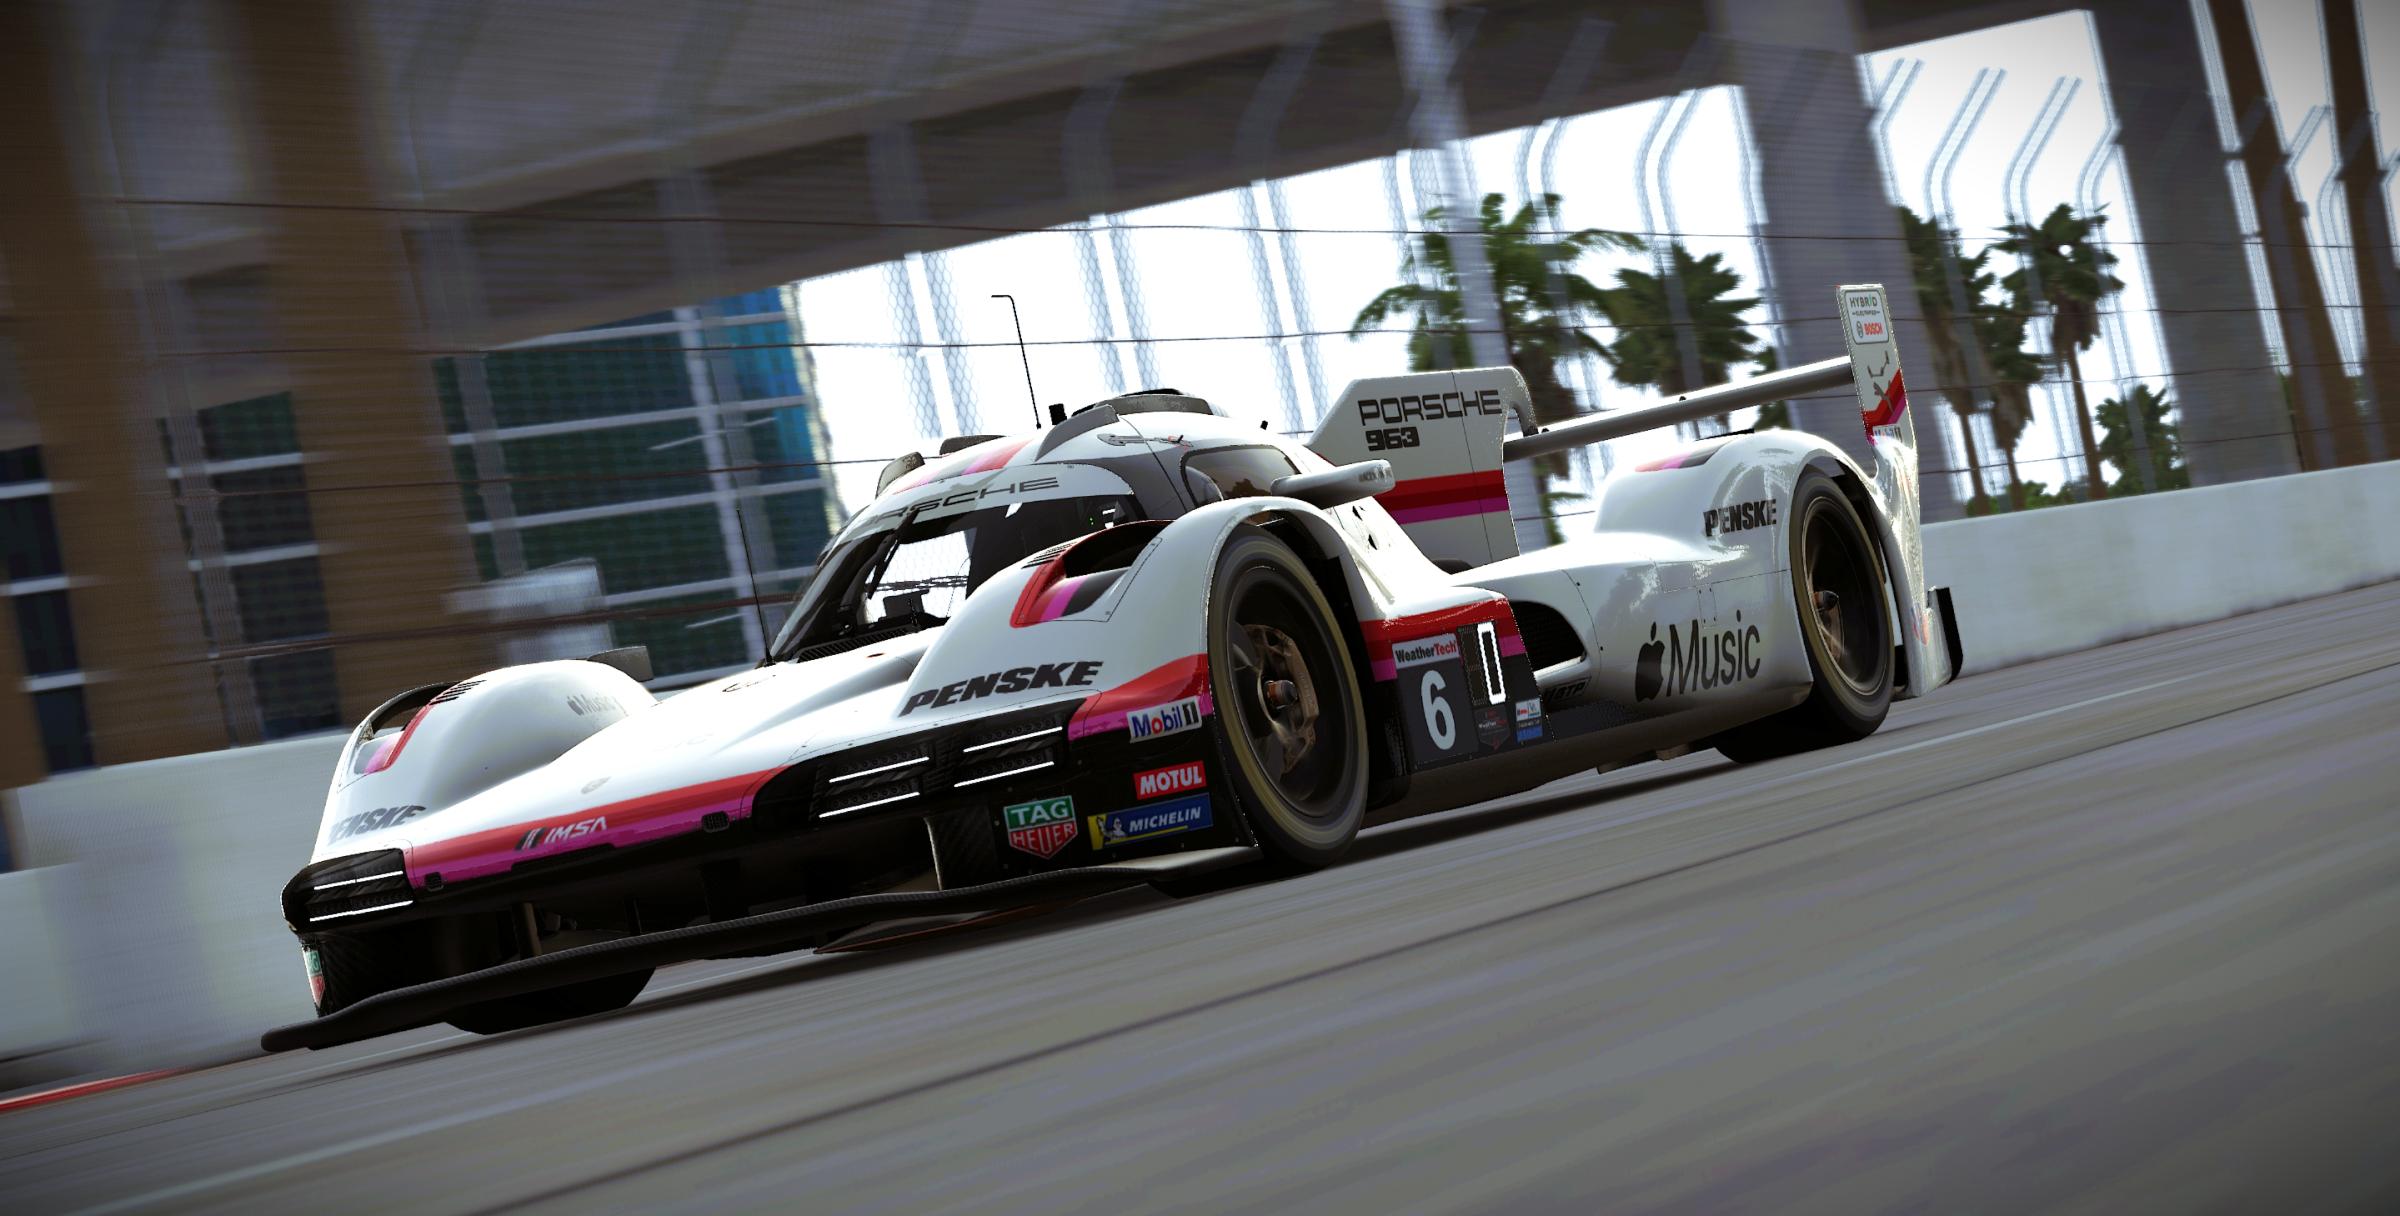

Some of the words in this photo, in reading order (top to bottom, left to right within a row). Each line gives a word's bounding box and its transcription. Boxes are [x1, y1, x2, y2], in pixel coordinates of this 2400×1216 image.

[1850, 294, 1878, 308] HYBRID
[1864, 322, 1884, 336] BOSCH
[1358, 390, 1502, 426] PORSCHE
[1365, 426, 1420, 451] 963
[874, 476, 1060, 524] RSCHE
[1703, 499, 1777, 537] PENSKE
[1395, 640, 1457, 663] WeatherTech
[1666, 609, 1761, 697] Music
[897, 660, 1104, 718] PENSKE
[1131, 704, 1184, 737] Mobil
[1183, 702, 1199, 726] 1
[1421, 670, 1456, 750] 6
[1140, 765, 1203, 795] MOTUL
[328, 804, 427, 846] ENSKE
[1010, 800, 1069, 825] TAG
[1129, 806, 1201, 833] MICHELIN
[544, 816, 608, 844] IMSA
[1011, 823, 1074, 854] HEUER
